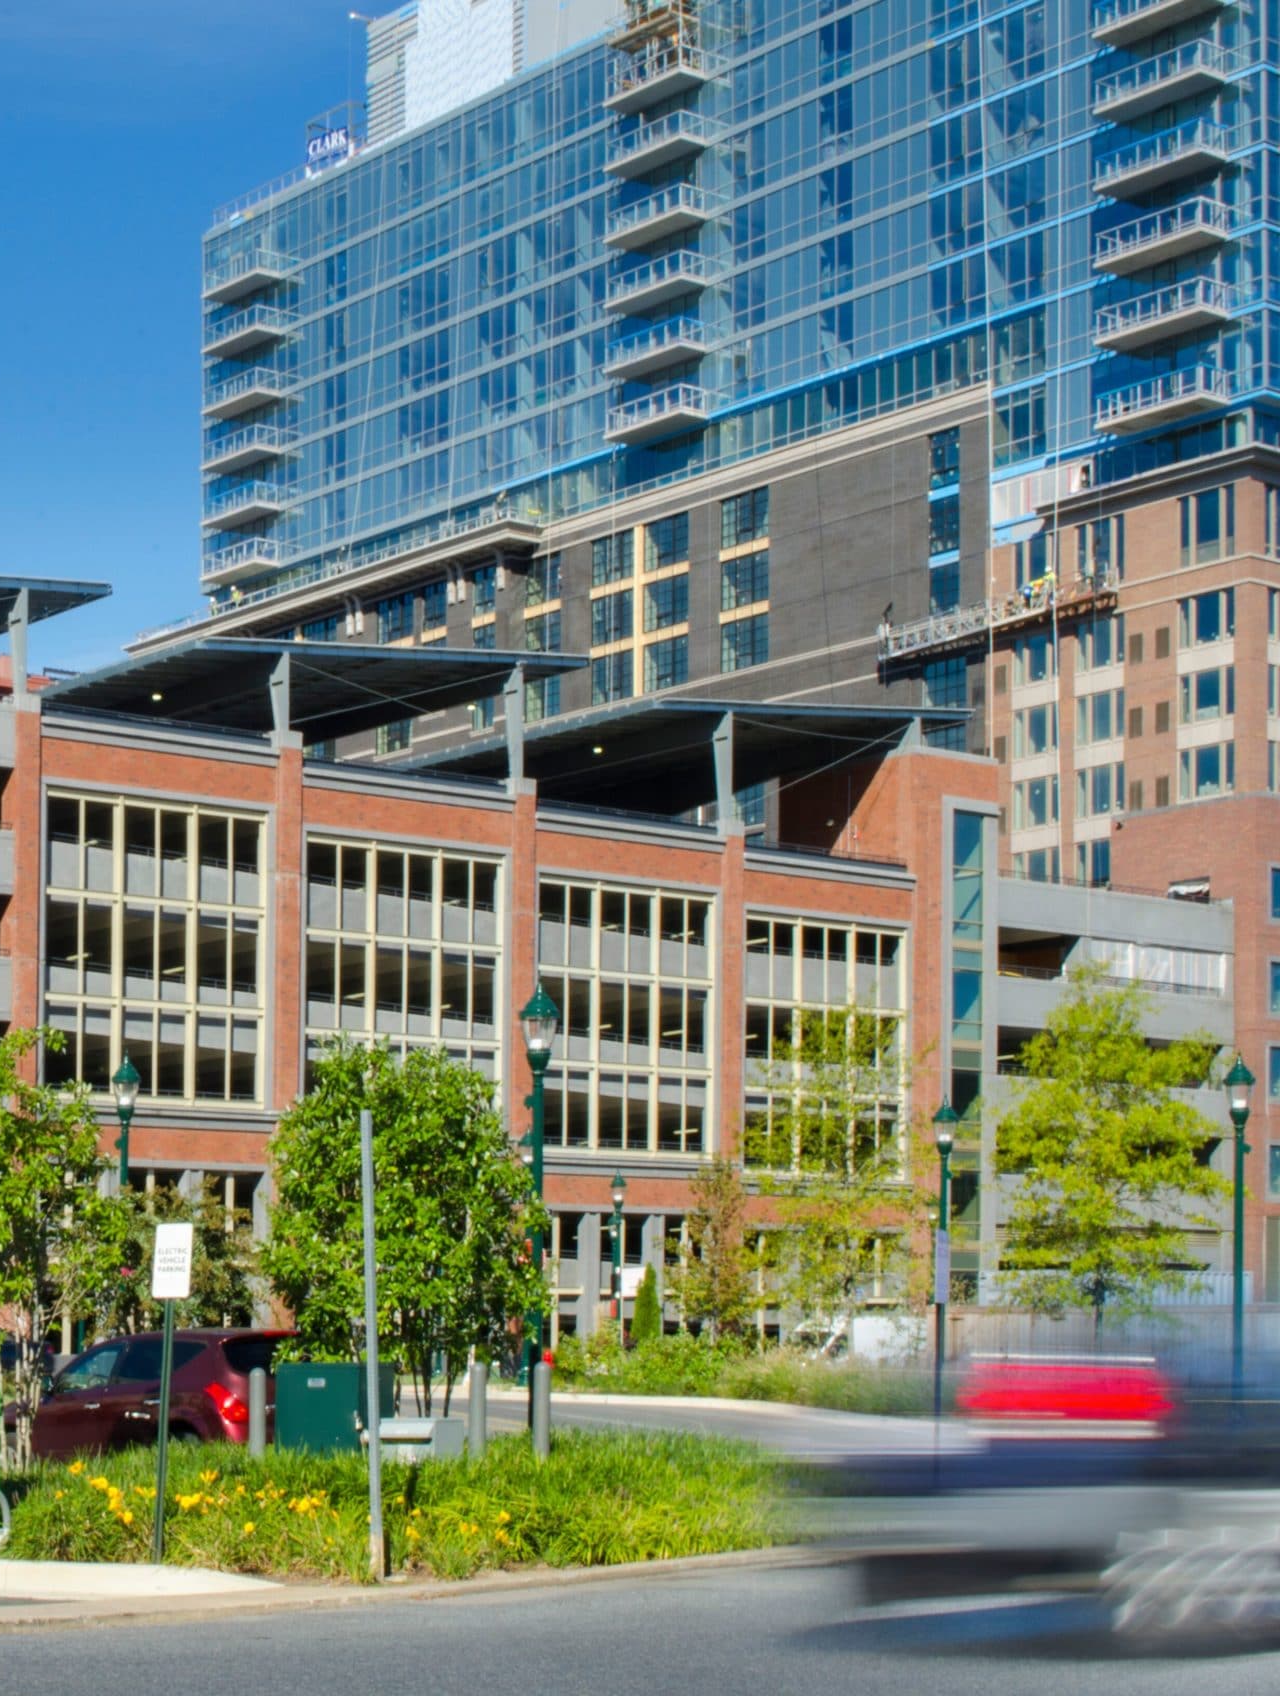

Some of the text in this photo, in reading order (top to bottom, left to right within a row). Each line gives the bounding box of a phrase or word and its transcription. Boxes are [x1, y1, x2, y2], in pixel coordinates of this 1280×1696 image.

[308, 129, 347, 156] CLARK
[158, 1247, 188, 1255] ELECTRIC
[159, 1256, 186, 1264] VEHICLE
[157, 1265, 186, 1273] PARKING
